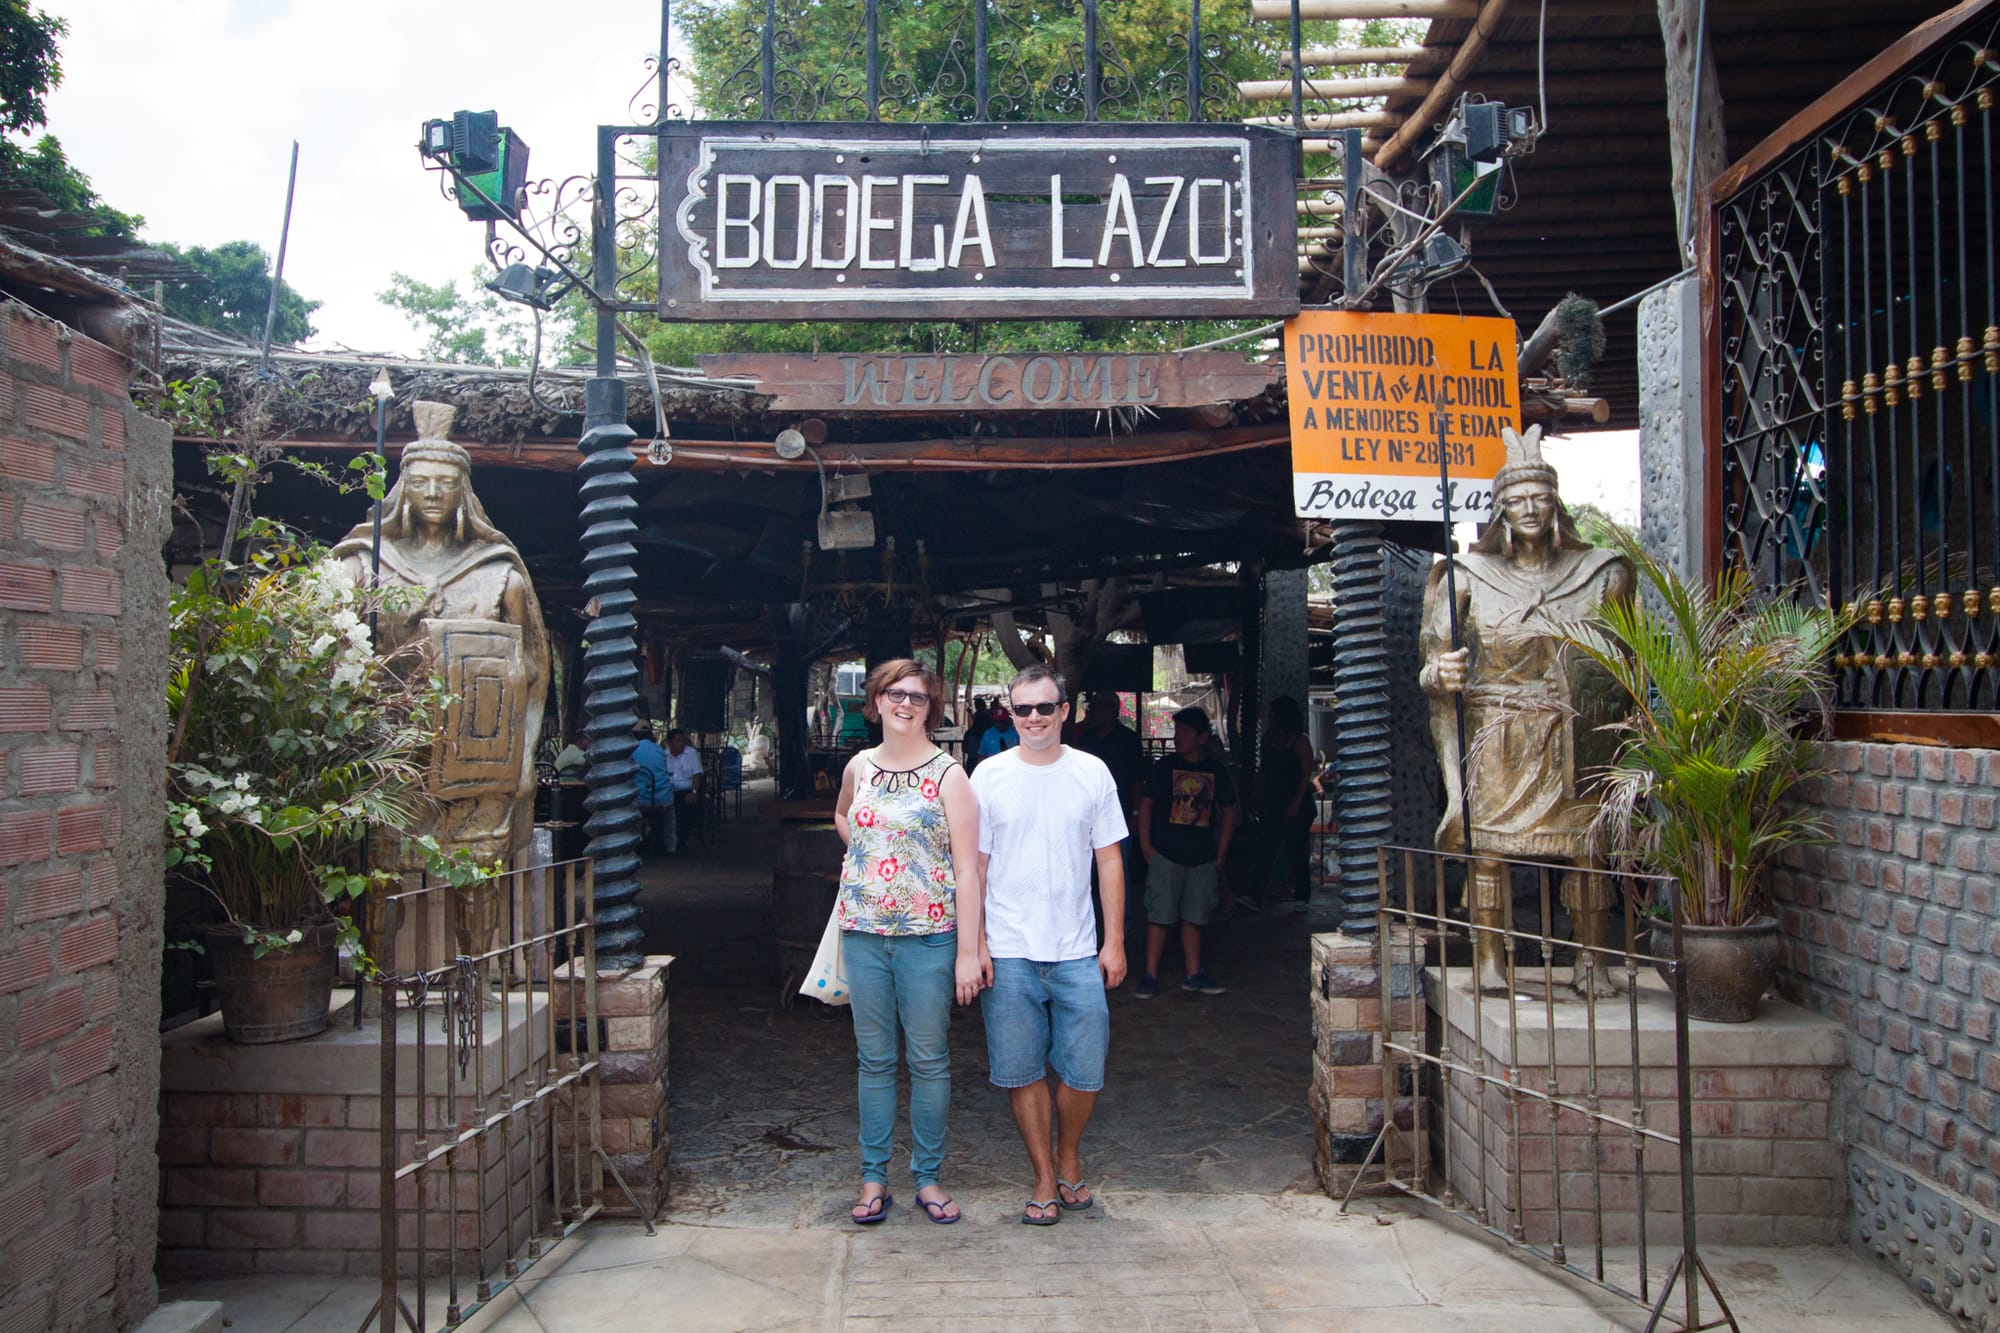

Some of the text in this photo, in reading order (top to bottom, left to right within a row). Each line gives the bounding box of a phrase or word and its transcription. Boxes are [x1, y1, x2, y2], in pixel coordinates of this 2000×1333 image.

[716, 173, 1232, 271] BODEGA LAZO
[1299, 333, 1504, 372] PROHIBIDO LA
[840, 355, 1160, 406] WELCOME
[1302, 370, 1512, 409] VENTA DE ALCOHOL
[1303, 407, 1318, 430] A
[1326, 408, 1419, 434] MENORES
[1429, 412, 1455, 436] DE
[1341, 437, 1381, 462] LEY
[1300, 480, 1493, 517] Bodega Laz
